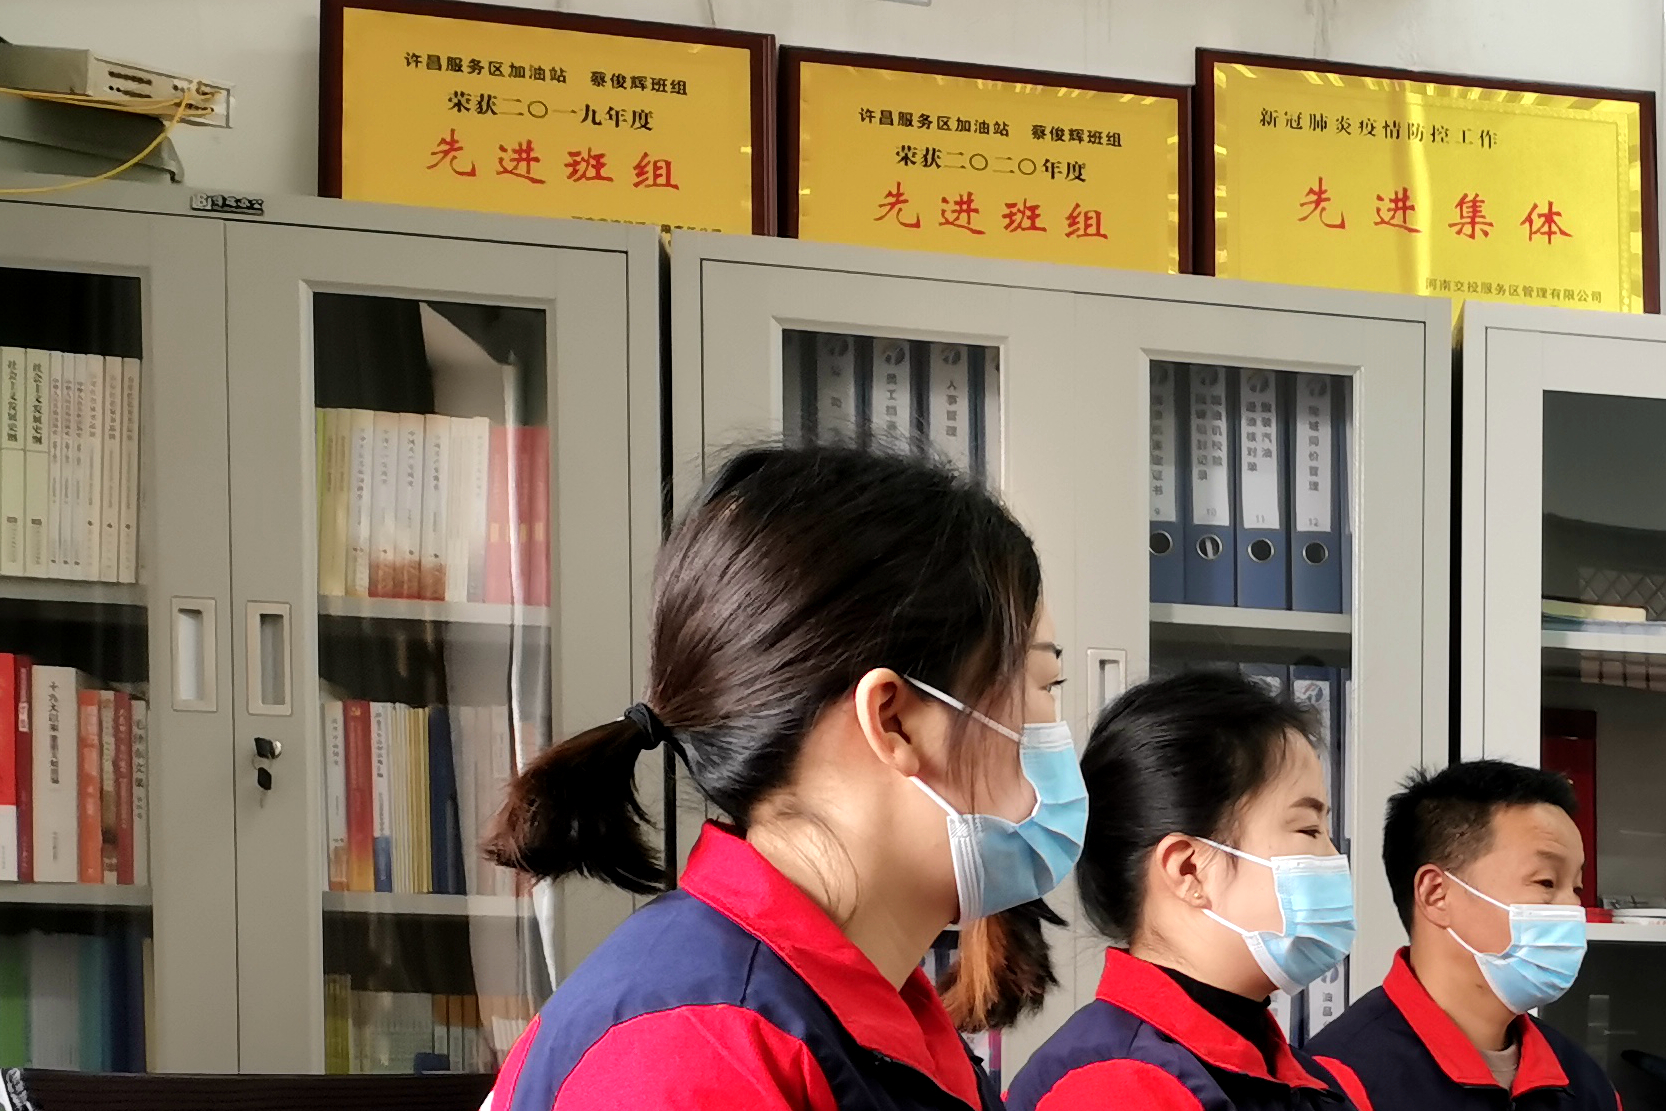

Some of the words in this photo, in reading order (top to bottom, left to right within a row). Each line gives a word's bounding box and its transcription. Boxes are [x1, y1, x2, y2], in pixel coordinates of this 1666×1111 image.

[404, 51, 568, 85] 许昌服务区加油站
[590, 71, 689, 97] 蔡俊辉班组
[858, 107, 1010, 138] 许昌服务区加油站
[1031, 124, 1123, 148] 蔡俊辉班组
[1258, 107, 1499, 150] 新冠肺炎疫情防控工作
[426, 127, 681, 192] 先进班组
[873, 180, 1109, 240] 先进班组
[1296, 175, 1573, 245] 先进集体
[1425, 276, 1602, 304] 河南交投服务区管理有限公司
